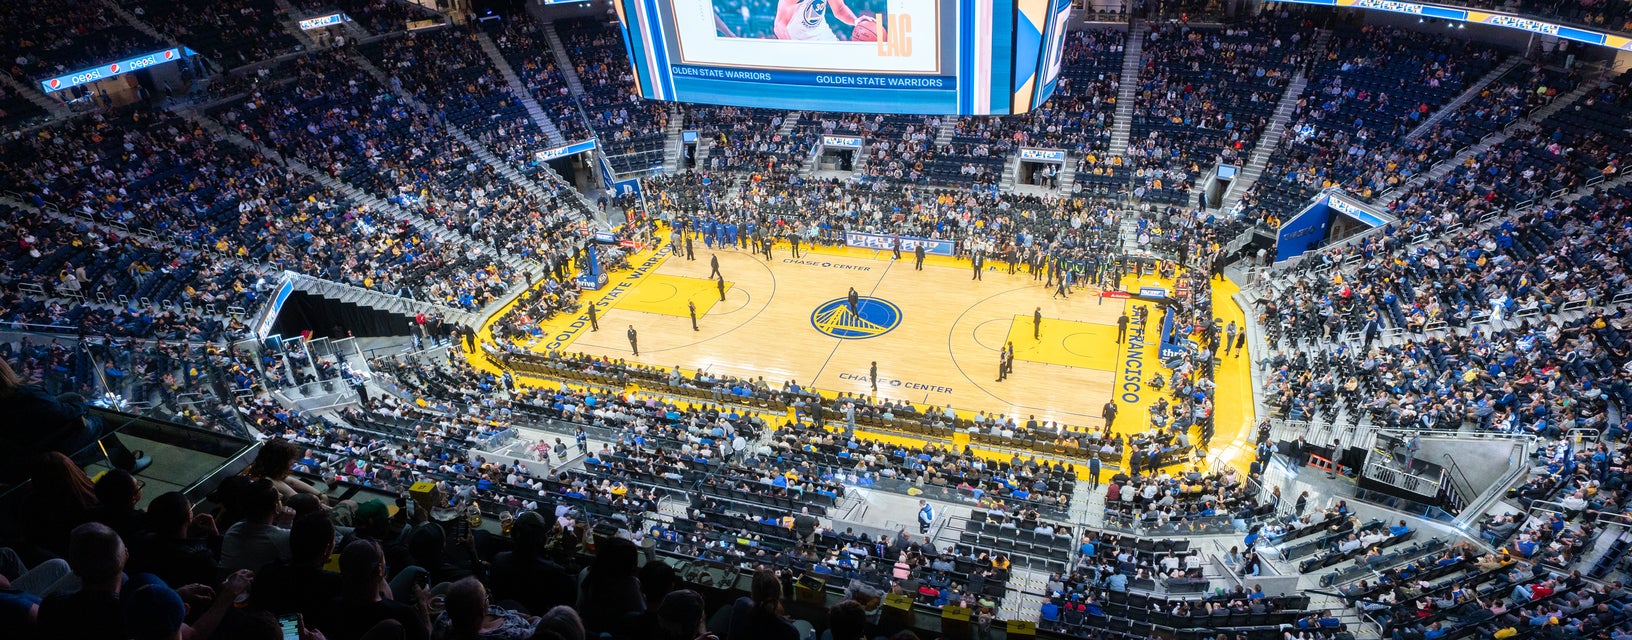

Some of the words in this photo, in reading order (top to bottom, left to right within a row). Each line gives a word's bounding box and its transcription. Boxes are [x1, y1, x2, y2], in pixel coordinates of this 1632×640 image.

[875, 13, 913, 58] LAC
[129, 54, 156, 71] pepsi
[71, 69, 101, 86] pepsi
[699, 68, 724, 78] STATE
[724, 70, 772, 81] WARRIORS
[815, 75, 855, 86] GOLDEN
[856, 77, 886, 86] STATE
[887, 78, 943, 88] WARRIORS
[782, 258, 820, 267] CHASE
[833, 263, 871, 272] CENTER
[595, 281, 632, 310] STATE
[1121, 327, 1145, 404] FRANCISCO
[838, 372, 888, 384] CHAE
[904, 381, 953, 394] CENTER
